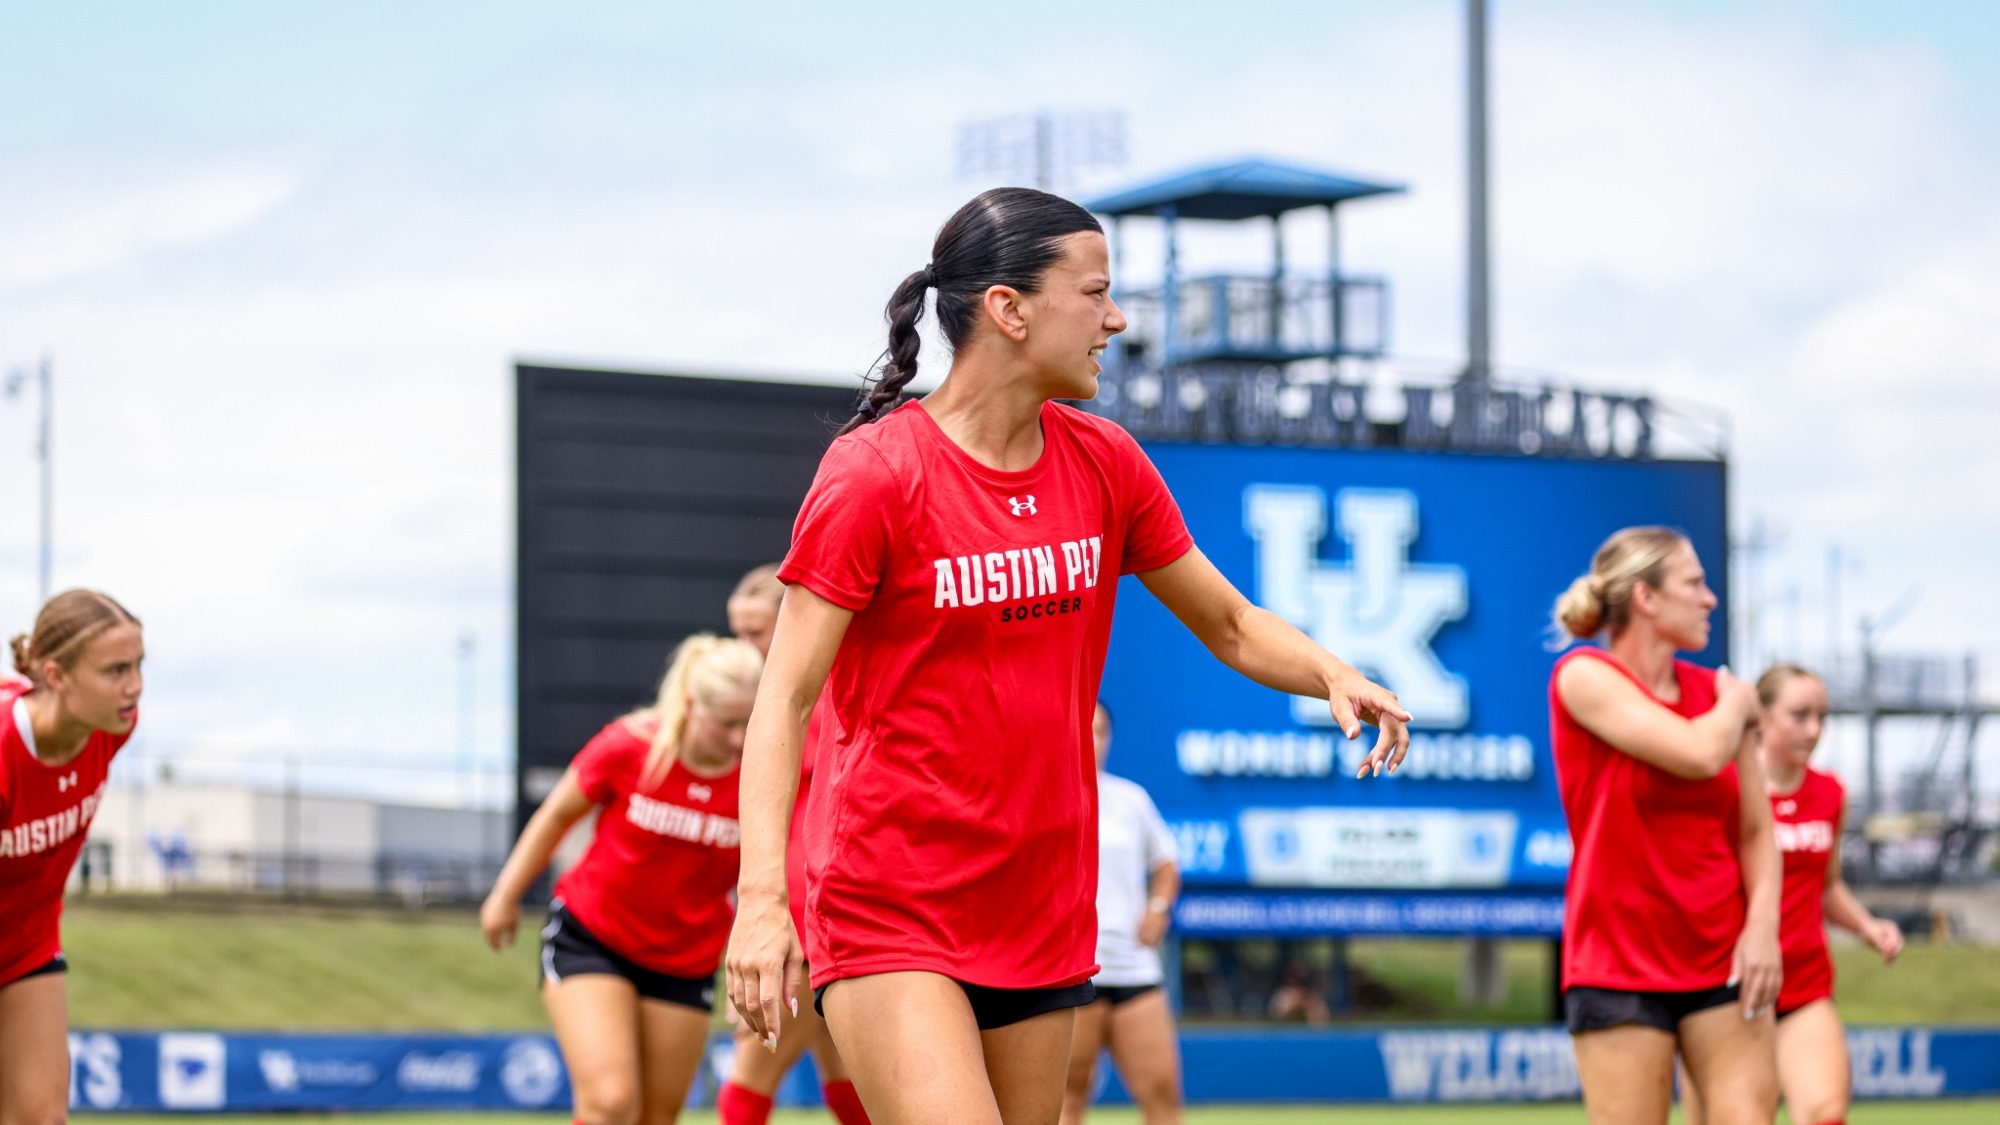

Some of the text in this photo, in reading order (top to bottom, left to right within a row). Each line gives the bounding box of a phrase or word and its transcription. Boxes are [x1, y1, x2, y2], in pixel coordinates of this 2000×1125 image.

[934, 533, 1104, 609] AUSTIN PEA
[1001, 597, 1082, 623] SOCCER
[1375, 1028, 1583, 1098] WELCO
